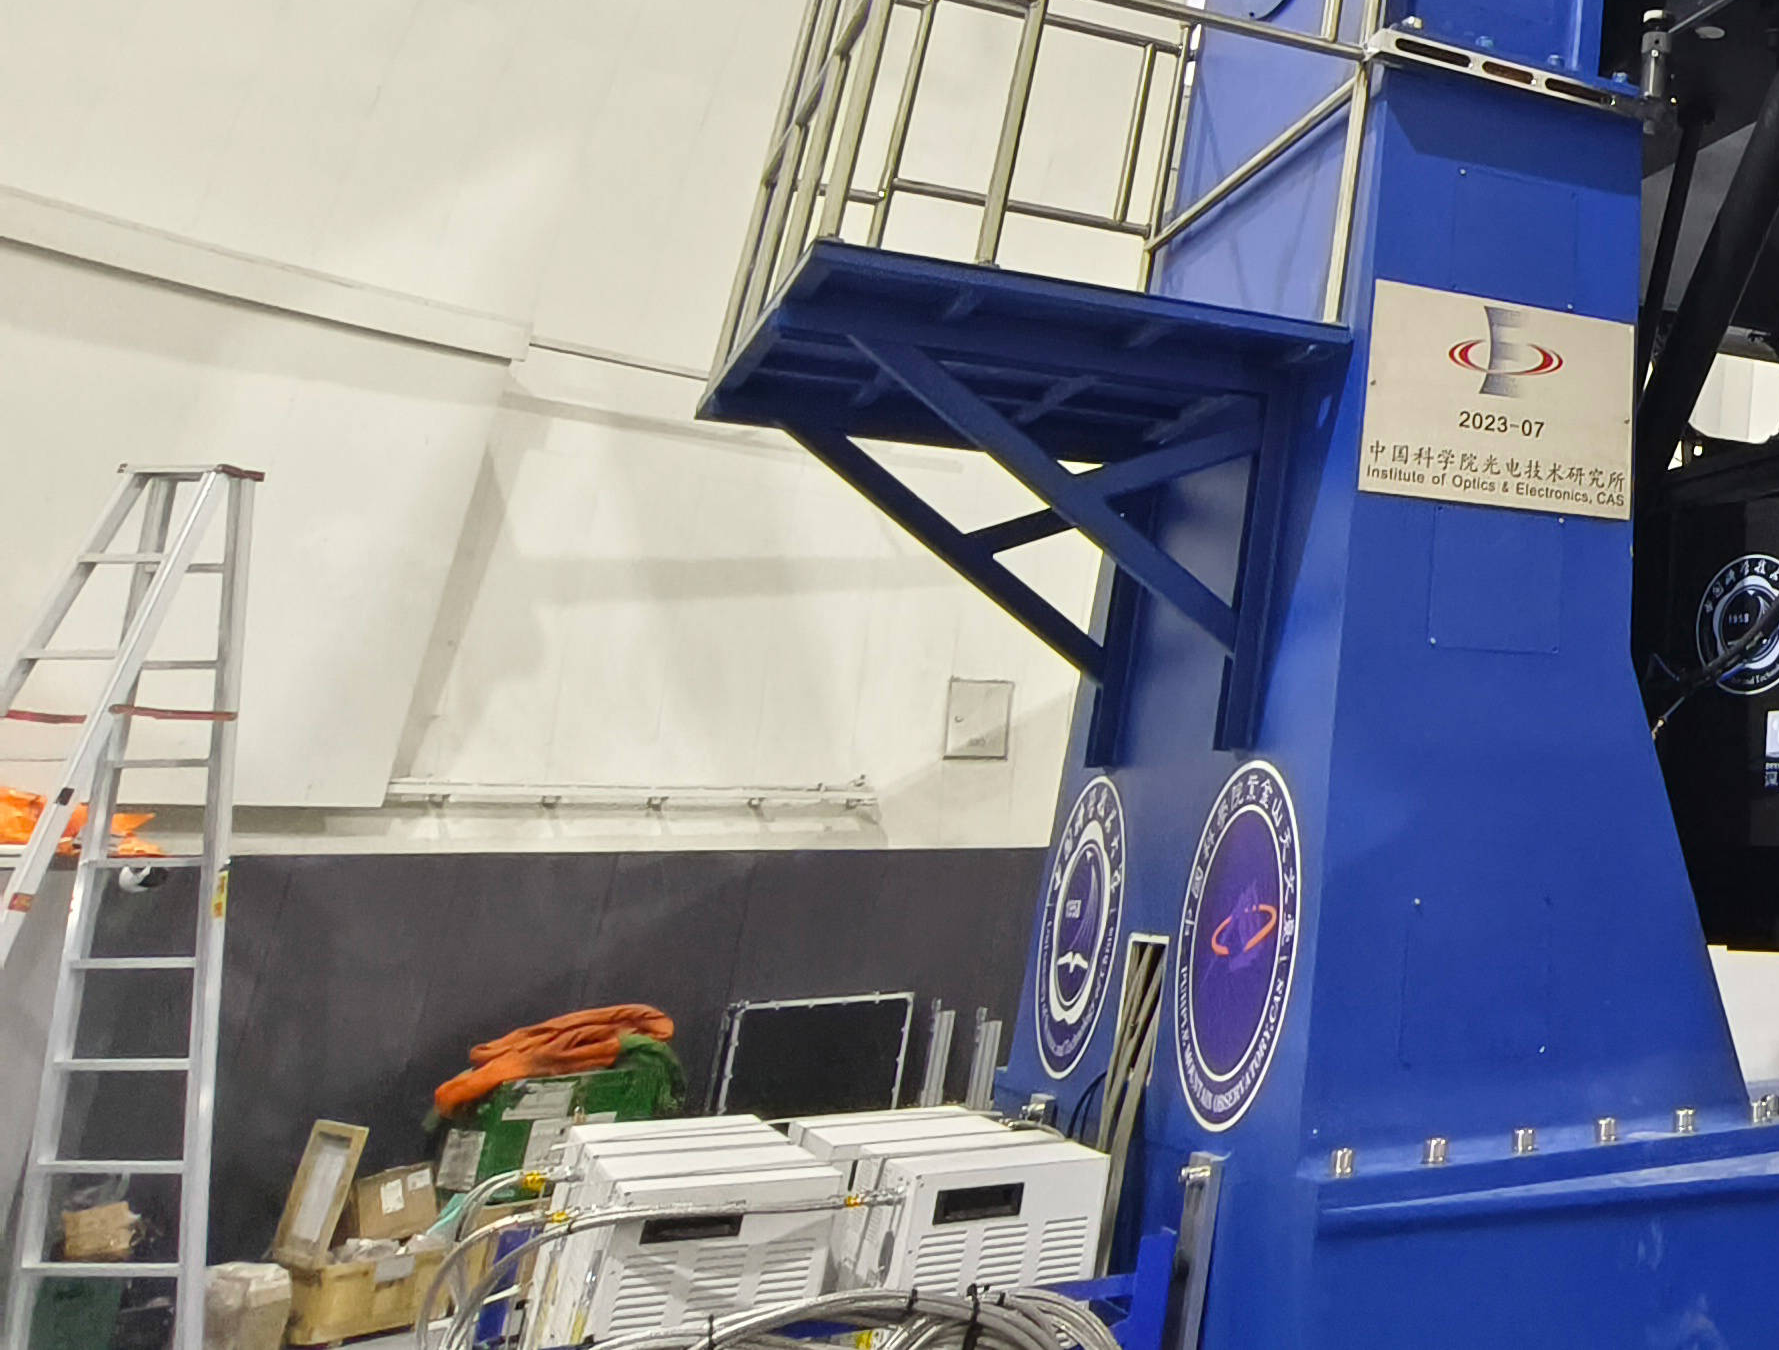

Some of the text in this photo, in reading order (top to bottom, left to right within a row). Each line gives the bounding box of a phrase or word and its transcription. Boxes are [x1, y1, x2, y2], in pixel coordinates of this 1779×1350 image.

[1459, 411, 1545, 438] 2023-07
[1366, 465, 1625, 507] Institute of Optics & Electronics, CAS
[1370, 440, 1625, 492] 中国科学院光电技术研究所
